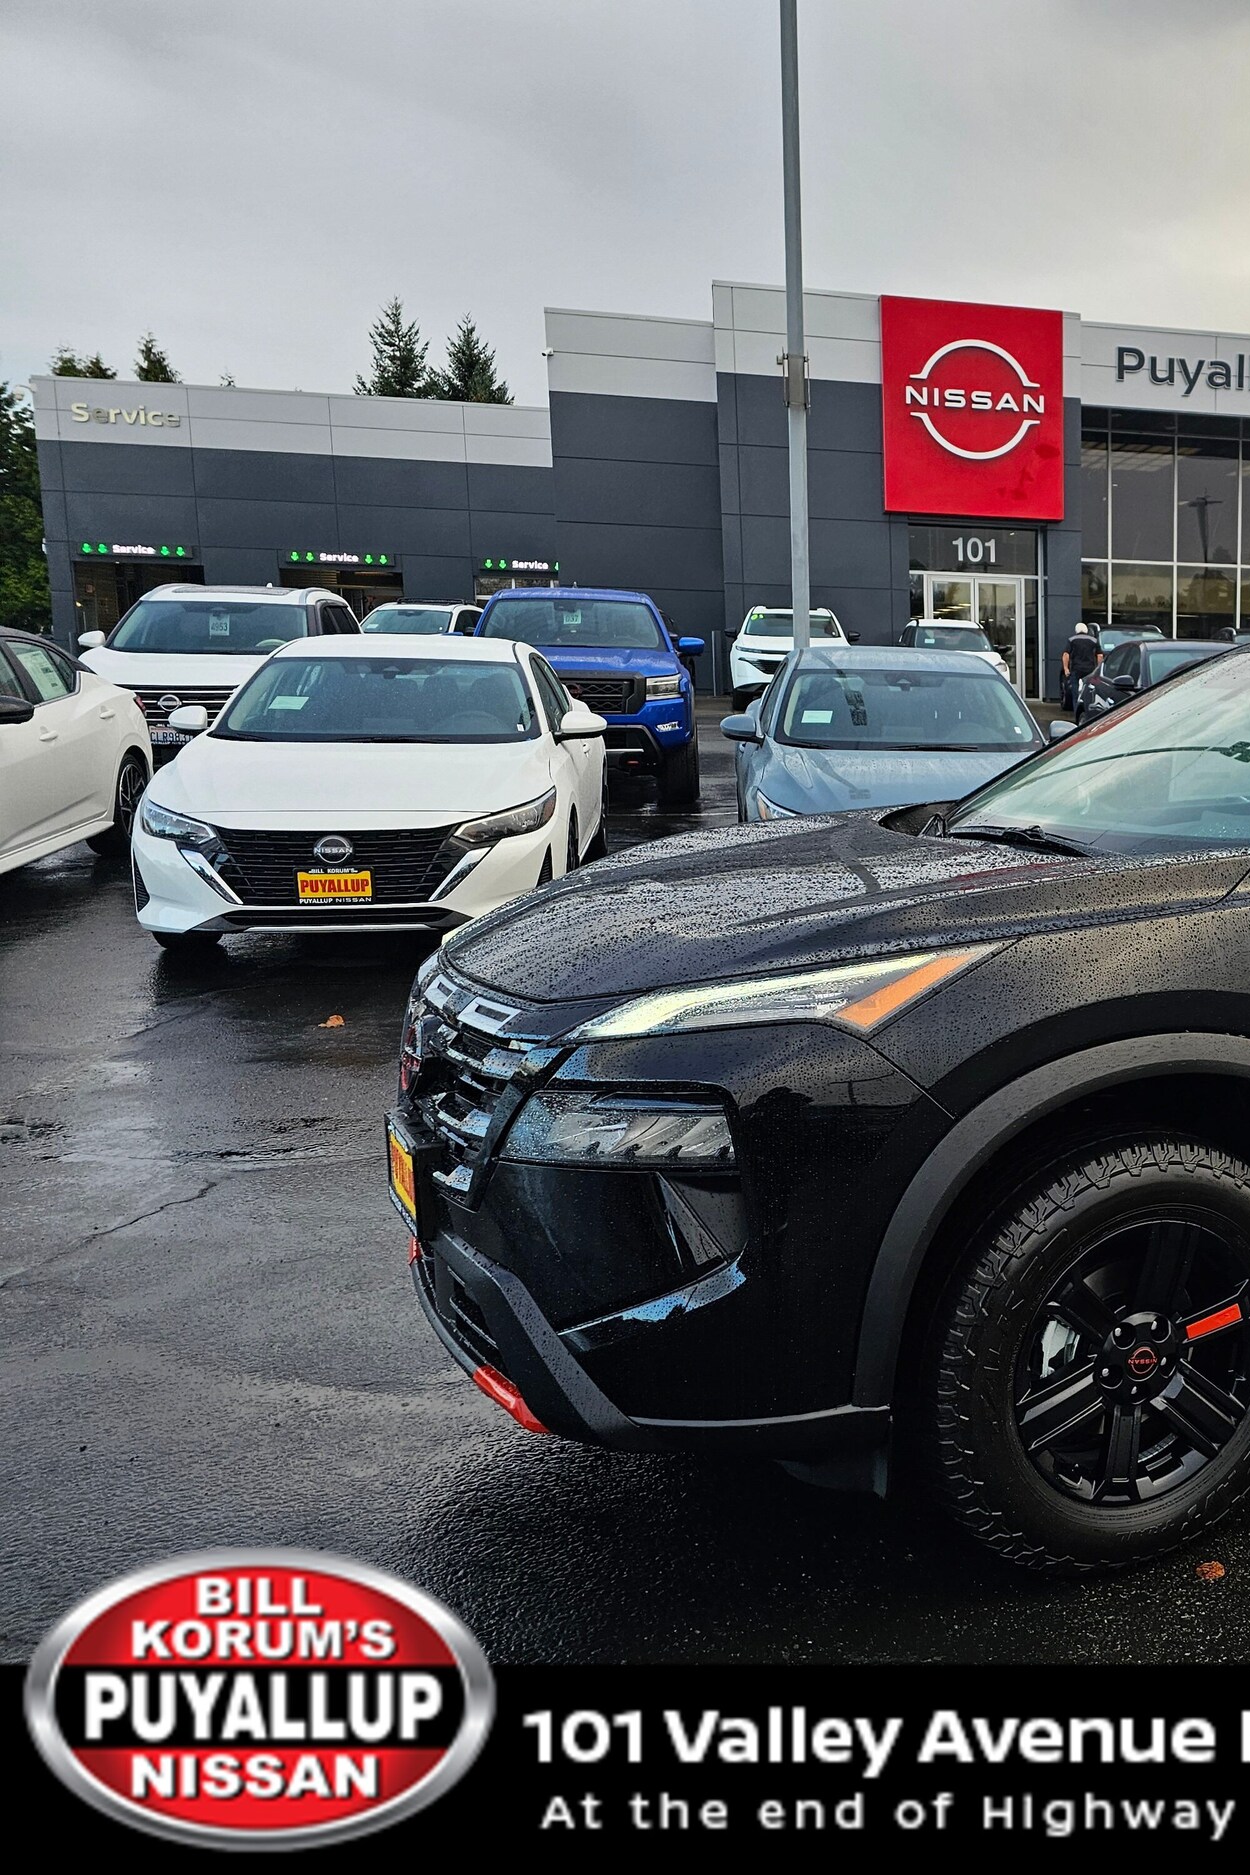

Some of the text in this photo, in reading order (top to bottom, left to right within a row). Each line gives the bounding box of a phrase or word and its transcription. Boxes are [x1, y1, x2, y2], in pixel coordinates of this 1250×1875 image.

[906, 385, 1044, 414] NISSAN
[71, 402, 181, 427] Service
[112, 544, 156, 555] Service
[952, 537, 996, 563] 101
[319, 552, 359, 563] Service
[512, 559, 549, 570] Service
[314, 846, 353, 854] NISSAN
[300, 879, 369, 893] PUYALLUP
